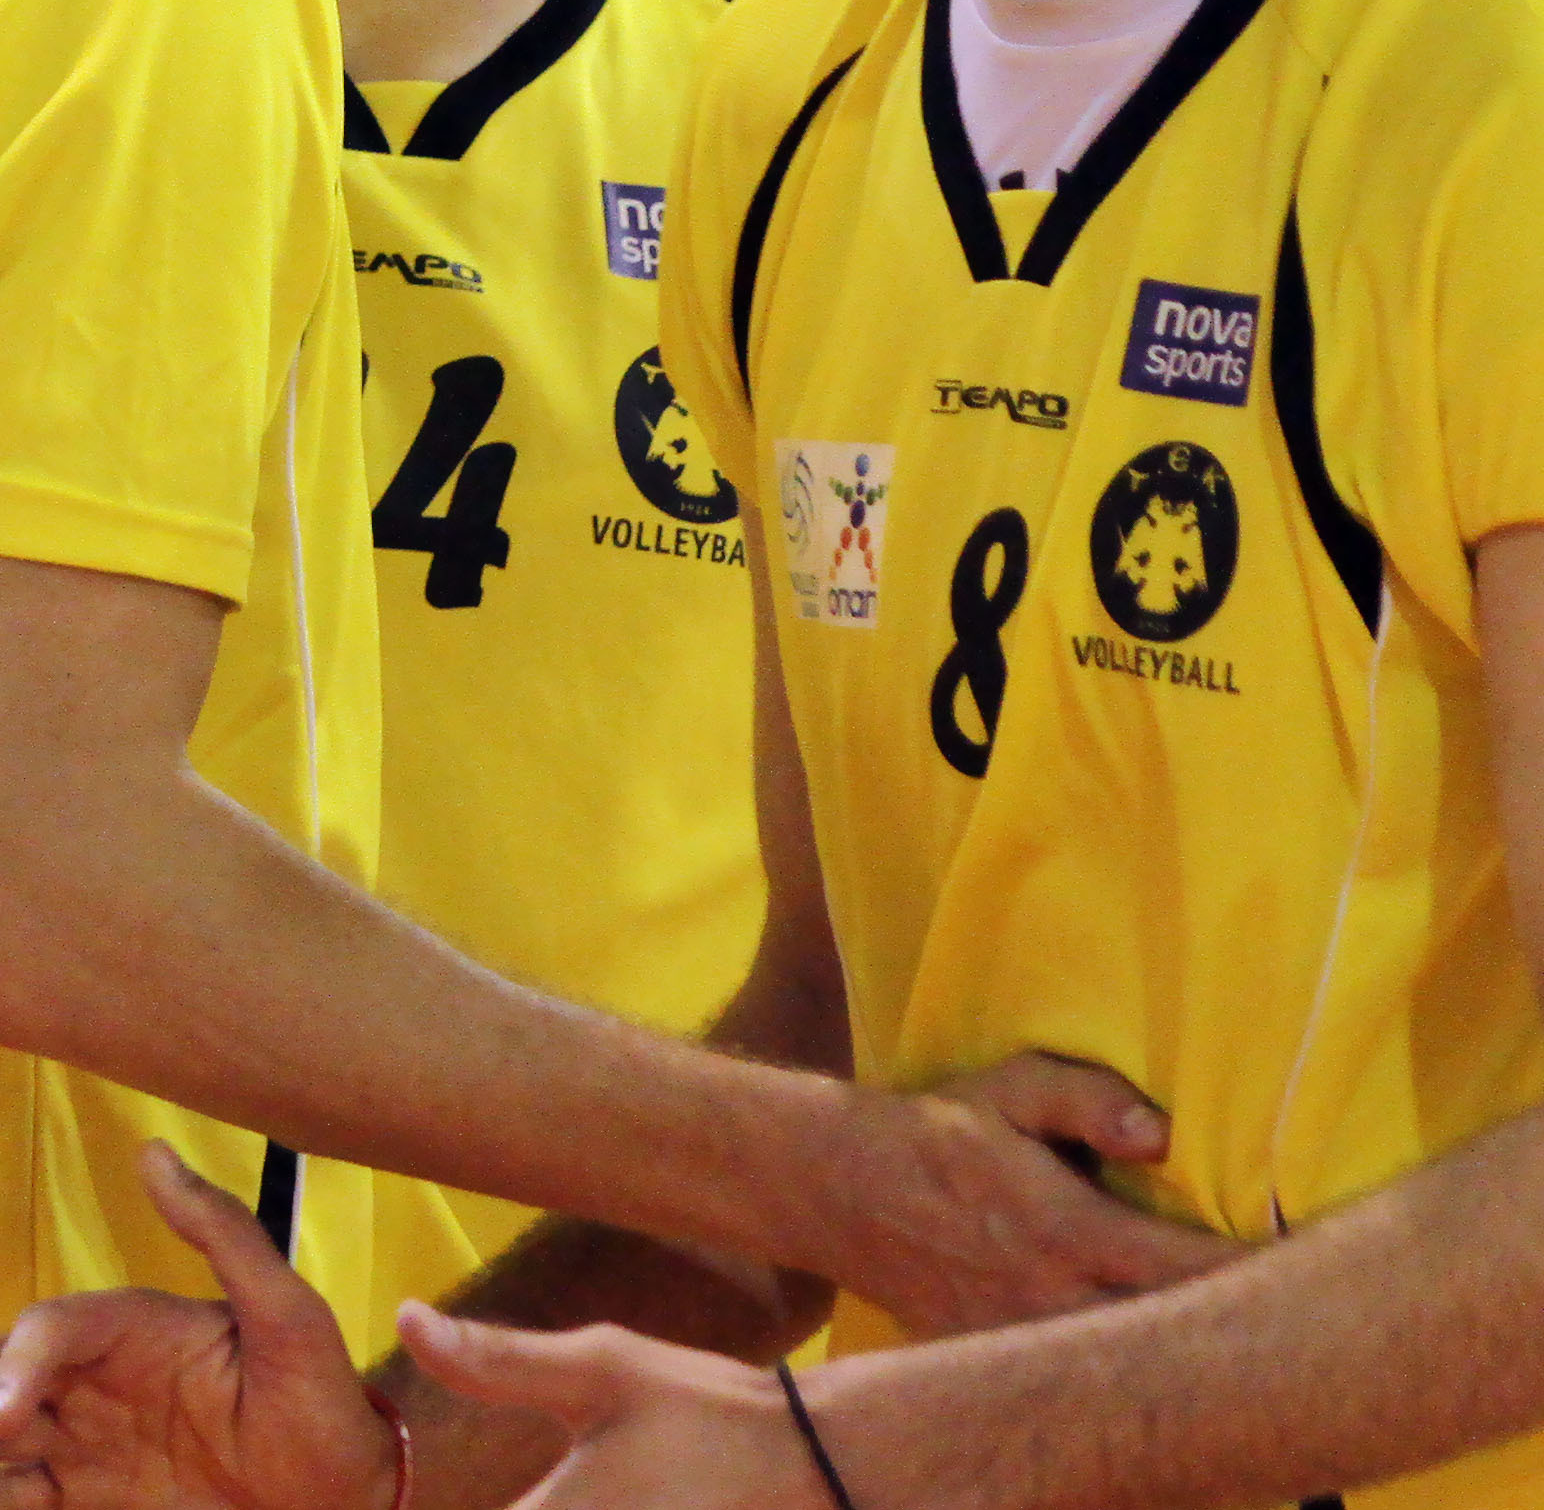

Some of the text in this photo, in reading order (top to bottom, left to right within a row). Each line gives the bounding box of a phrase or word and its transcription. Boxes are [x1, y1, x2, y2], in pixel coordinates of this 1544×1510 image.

[353, 249, 484, 288] EMPO
[1155, 298, 1253, 348] nova
[1143, 343, 1247, 387] sports
[931, 379, 1069, 430] TEMPO
[361, 348, 518, 608] 4
[592, 514, 746, 567] VOLLEYBA
[931, 508, 1029, 779] 8
[1072, 634, 1240, 695] VOLLEYBALL
